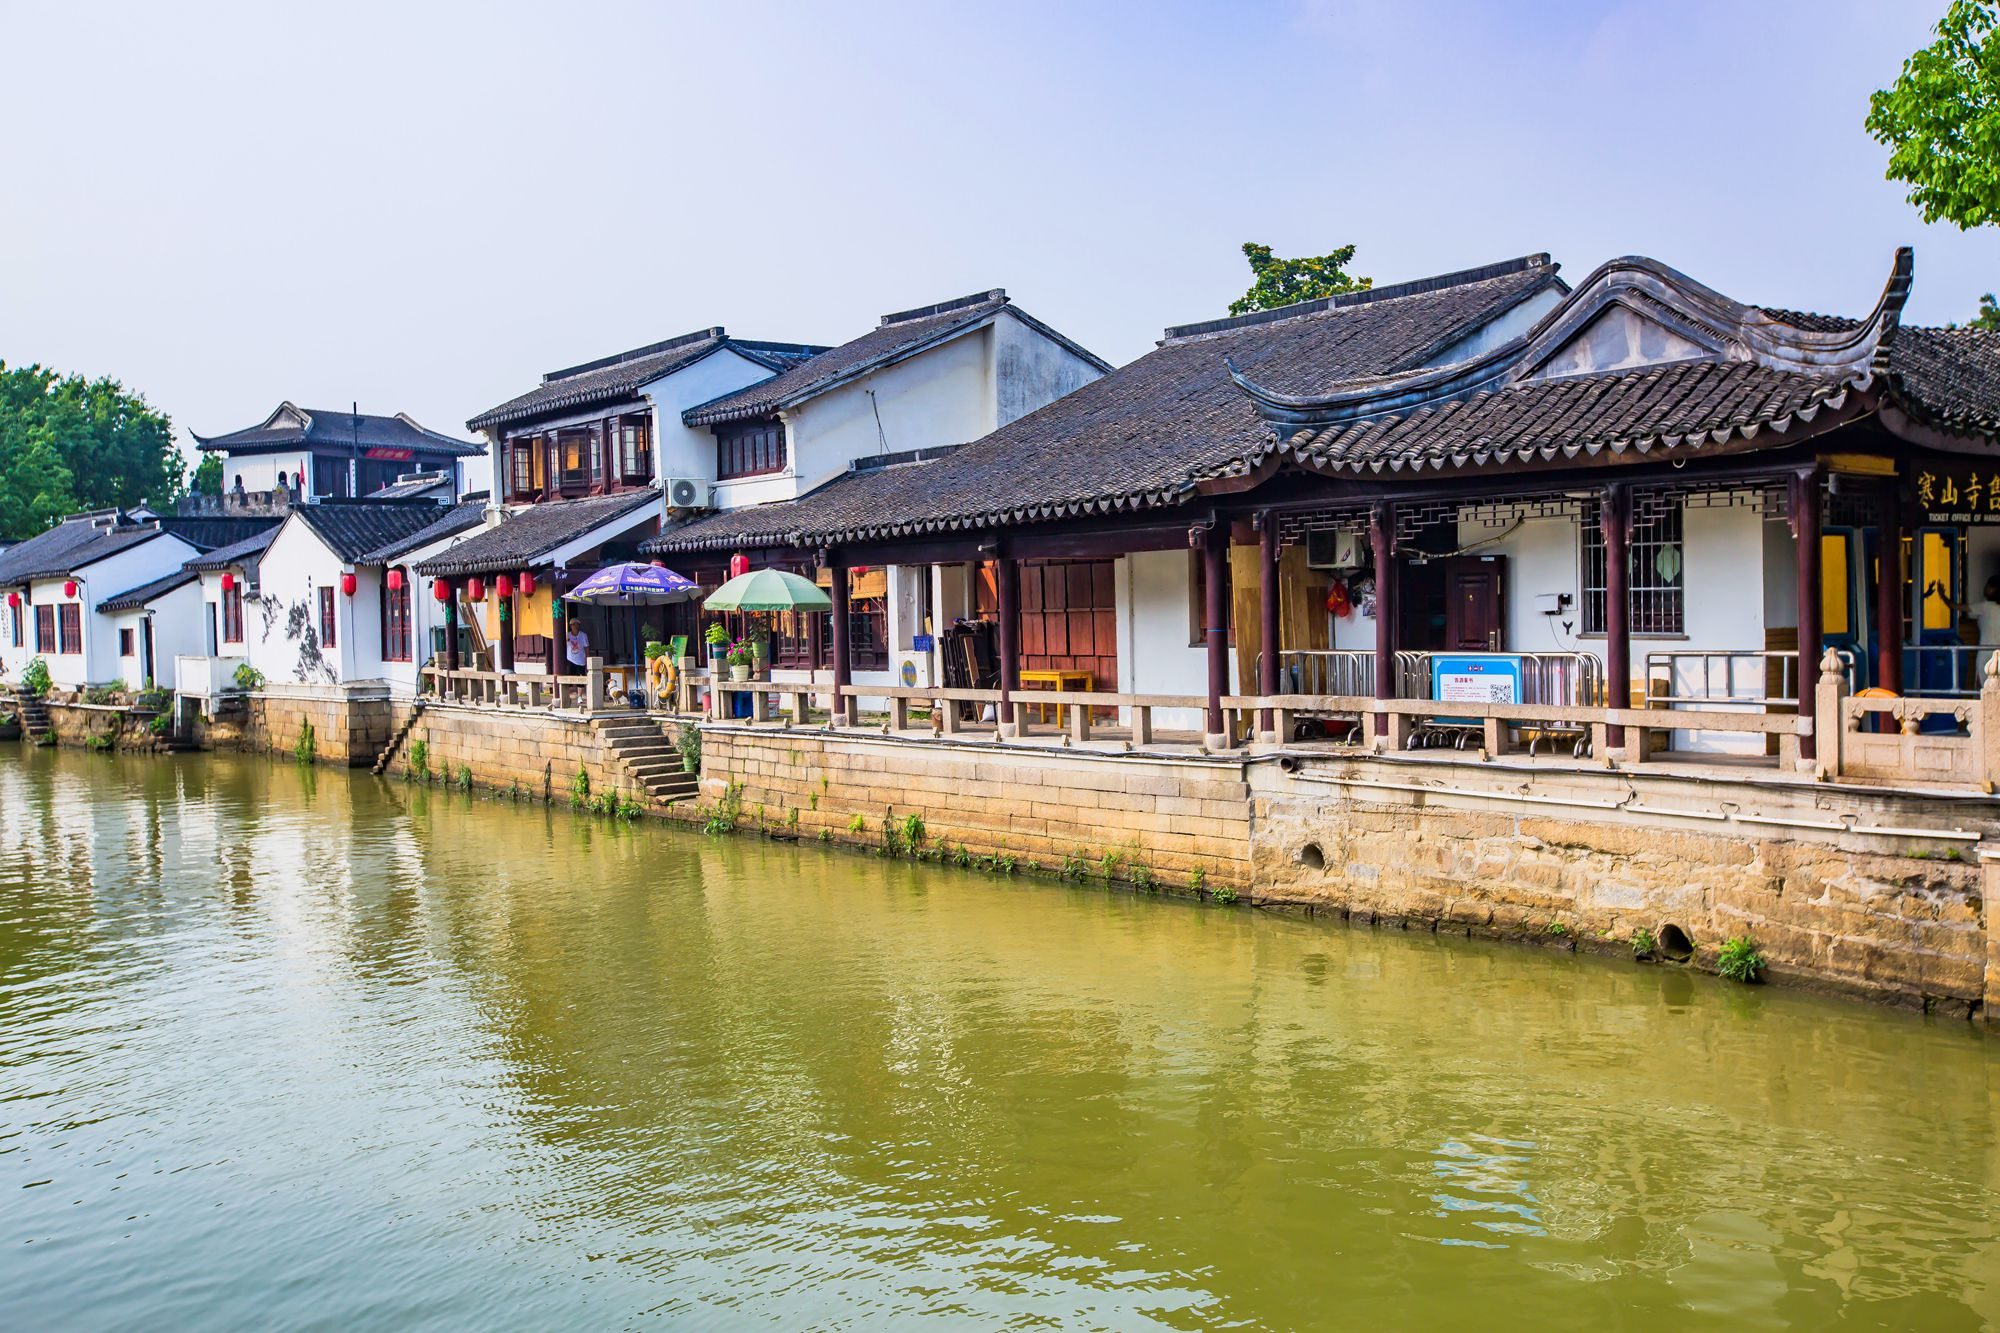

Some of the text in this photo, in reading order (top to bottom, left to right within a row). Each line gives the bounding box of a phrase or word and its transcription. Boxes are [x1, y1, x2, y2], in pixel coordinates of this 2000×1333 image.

[1929, 513, 1949, 522] TICKET
[1952, 513, 1971, 522] OFFICE
[1974, 514, 1981, 522] OF
